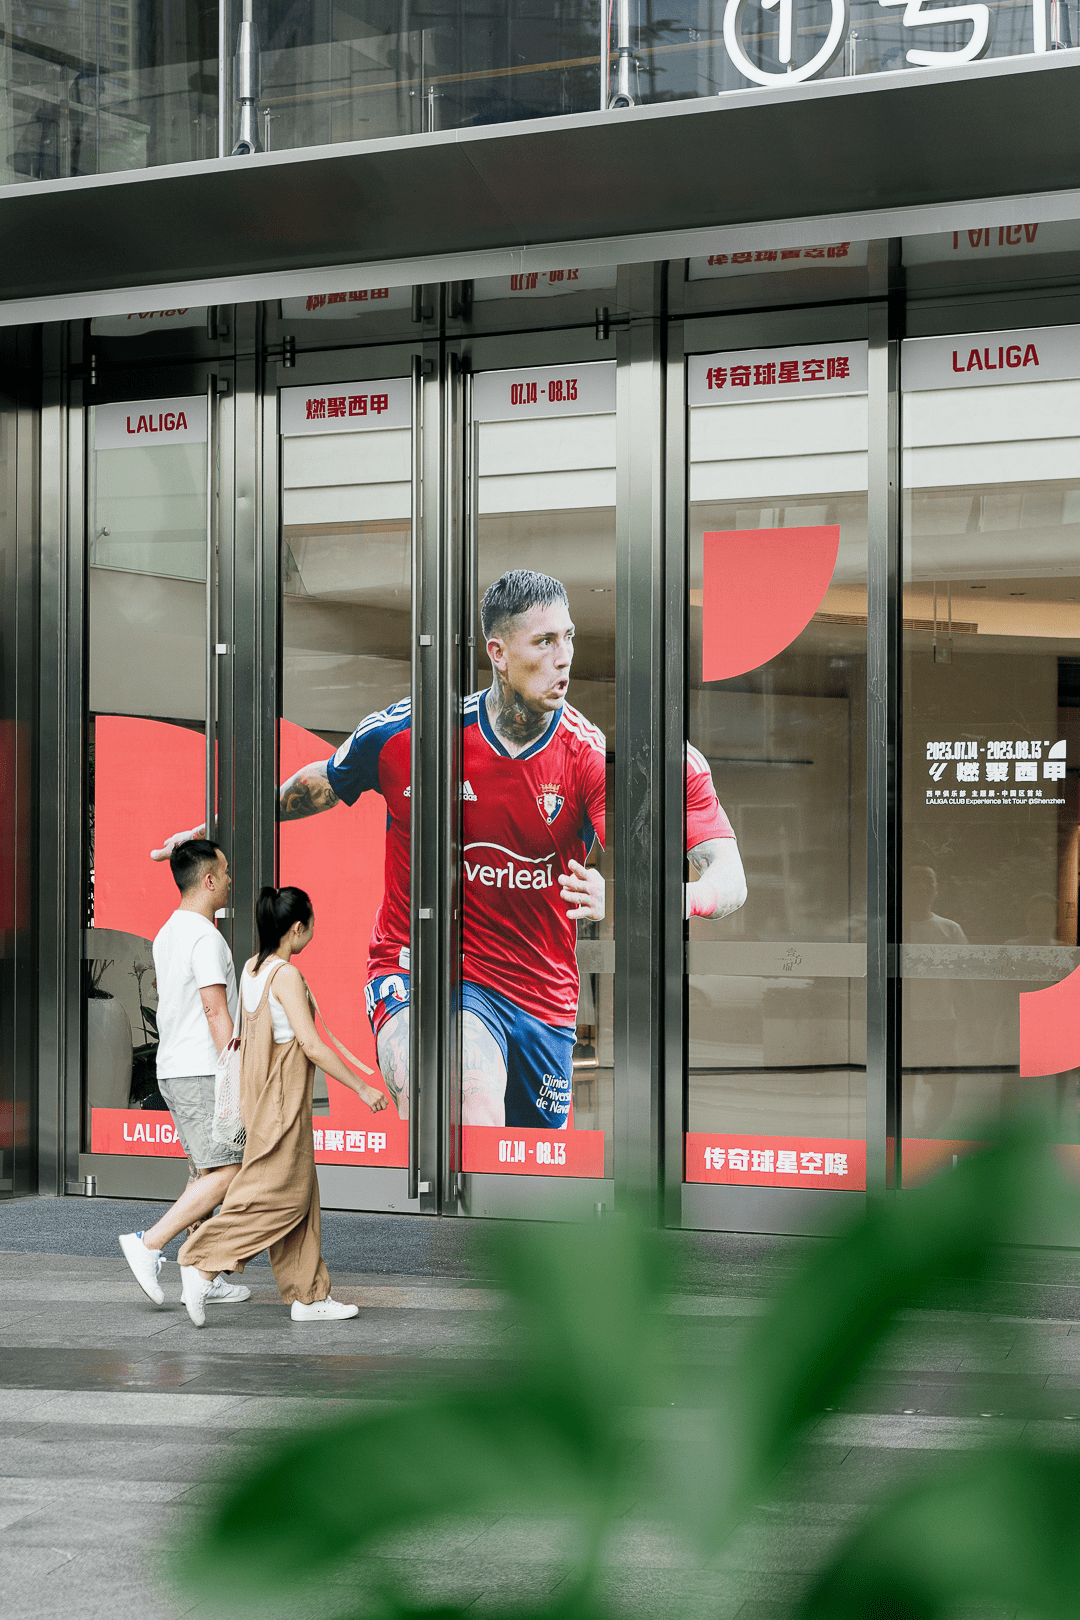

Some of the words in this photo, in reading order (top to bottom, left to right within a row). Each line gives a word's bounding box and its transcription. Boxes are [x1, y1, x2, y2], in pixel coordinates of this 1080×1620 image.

[952, 343, 1040, 373] LALIGA
[706, 356, 850, 390] 传奇球星空降
[306, 394, 388, 420] 燃聚西甲
[126, 411, 188, 433] LALIGA
[536, 1097, 548, 1110] de
[703, 1146, 848, 1176] 传奇球星空降
